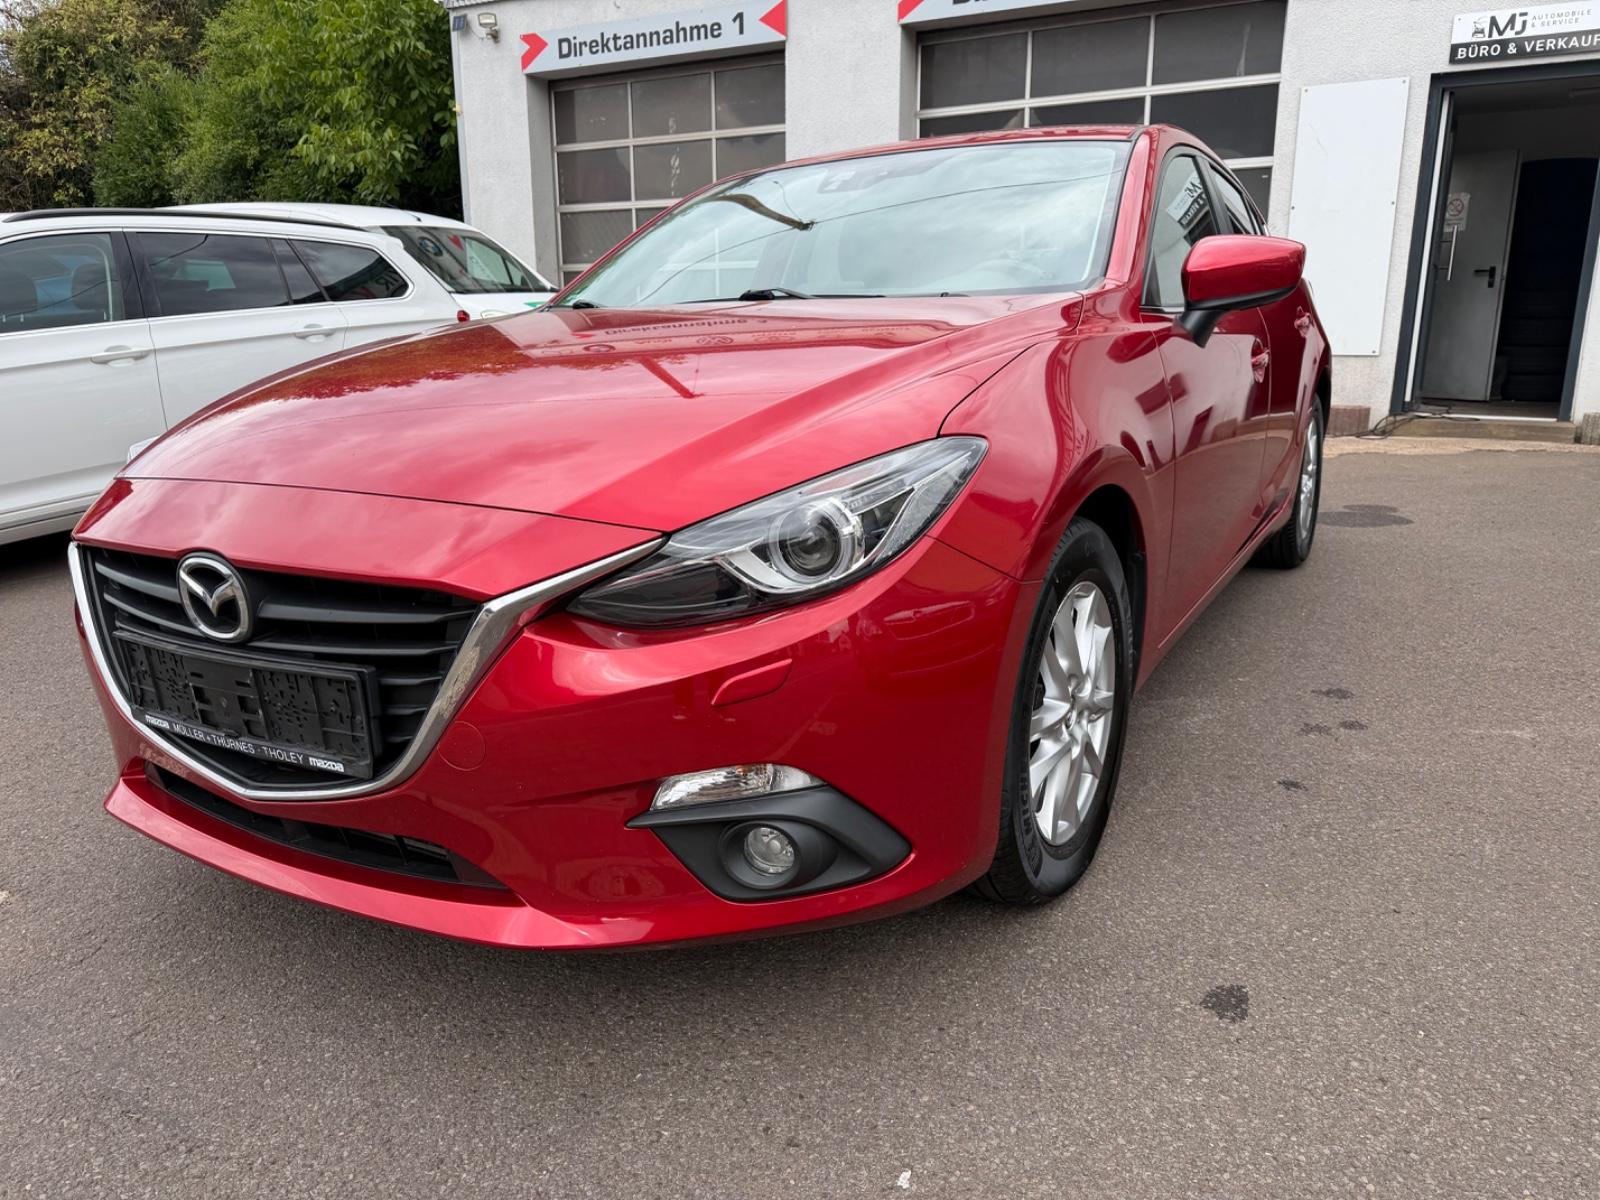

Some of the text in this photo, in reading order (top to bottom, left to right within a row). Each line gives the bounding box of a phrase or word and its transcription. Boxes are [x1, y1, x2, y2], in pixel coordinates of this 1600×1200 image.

[1532, 9, 1592, 20] AUTOMOBILE
[1541, 17, 1580, 27] SERVICE
[558, 12, 745, 59] Direktannahme 1
[1457, 33, 1600, 59] BÜRO & VERKAUF
[261, 746, 304, 765] THOLEY
